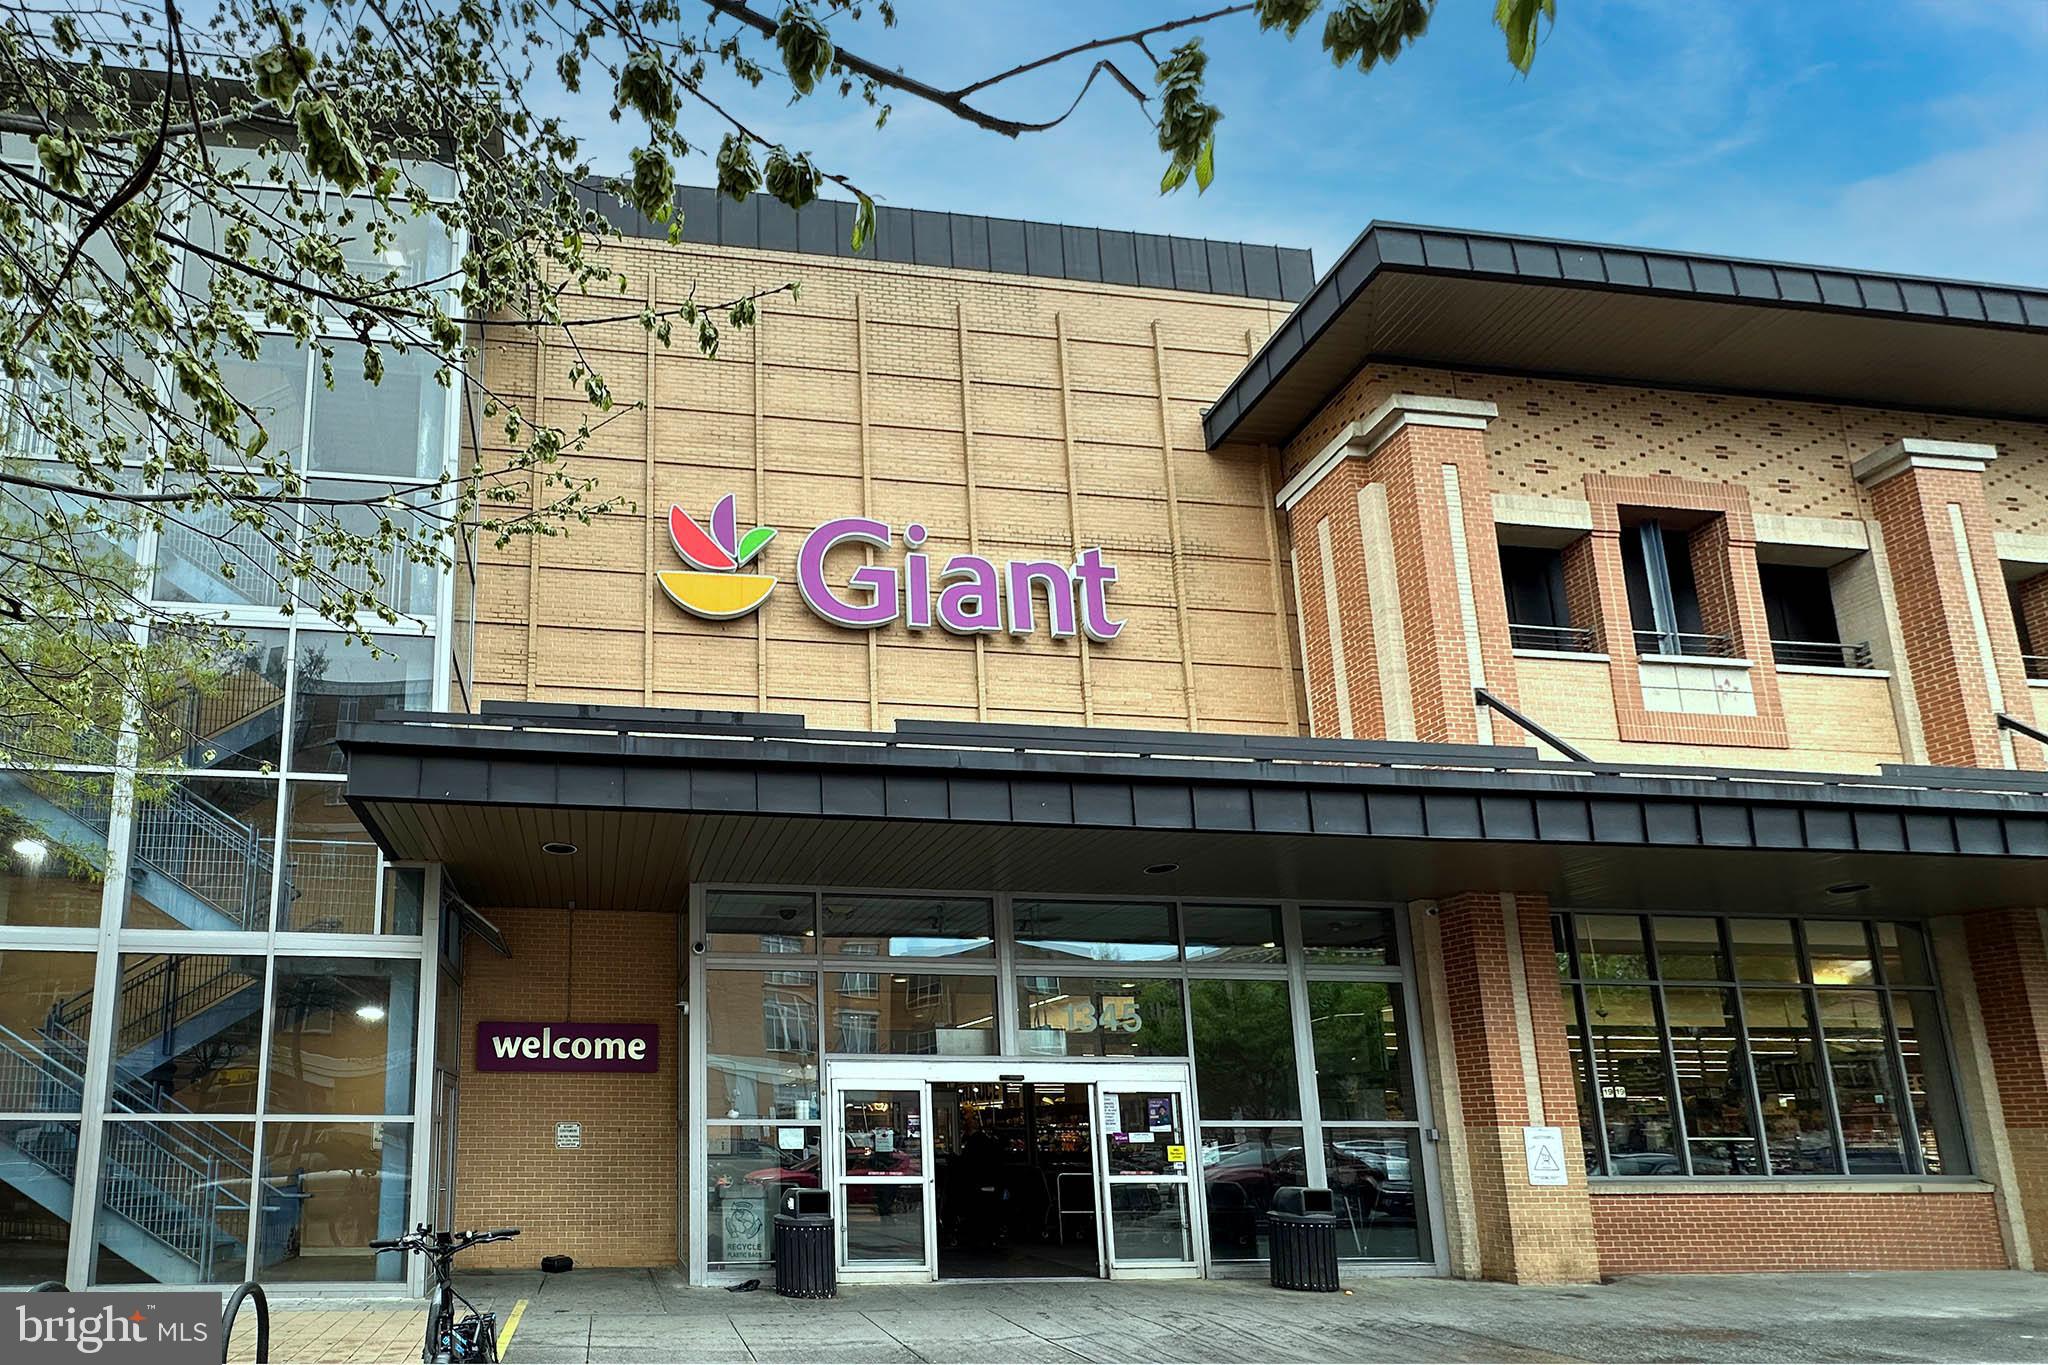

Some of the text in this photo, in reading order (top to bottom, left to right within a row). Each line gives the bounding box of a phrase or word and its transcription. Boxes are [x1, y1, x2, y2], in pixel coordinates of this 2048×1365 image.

[797, 517, 1128, 642] Giant
[1066, 1003, 1142, 1032] 1345
[492, 1027, 646, 1060] welcome
[727, 1243, 762, 1251] RECYCLE
